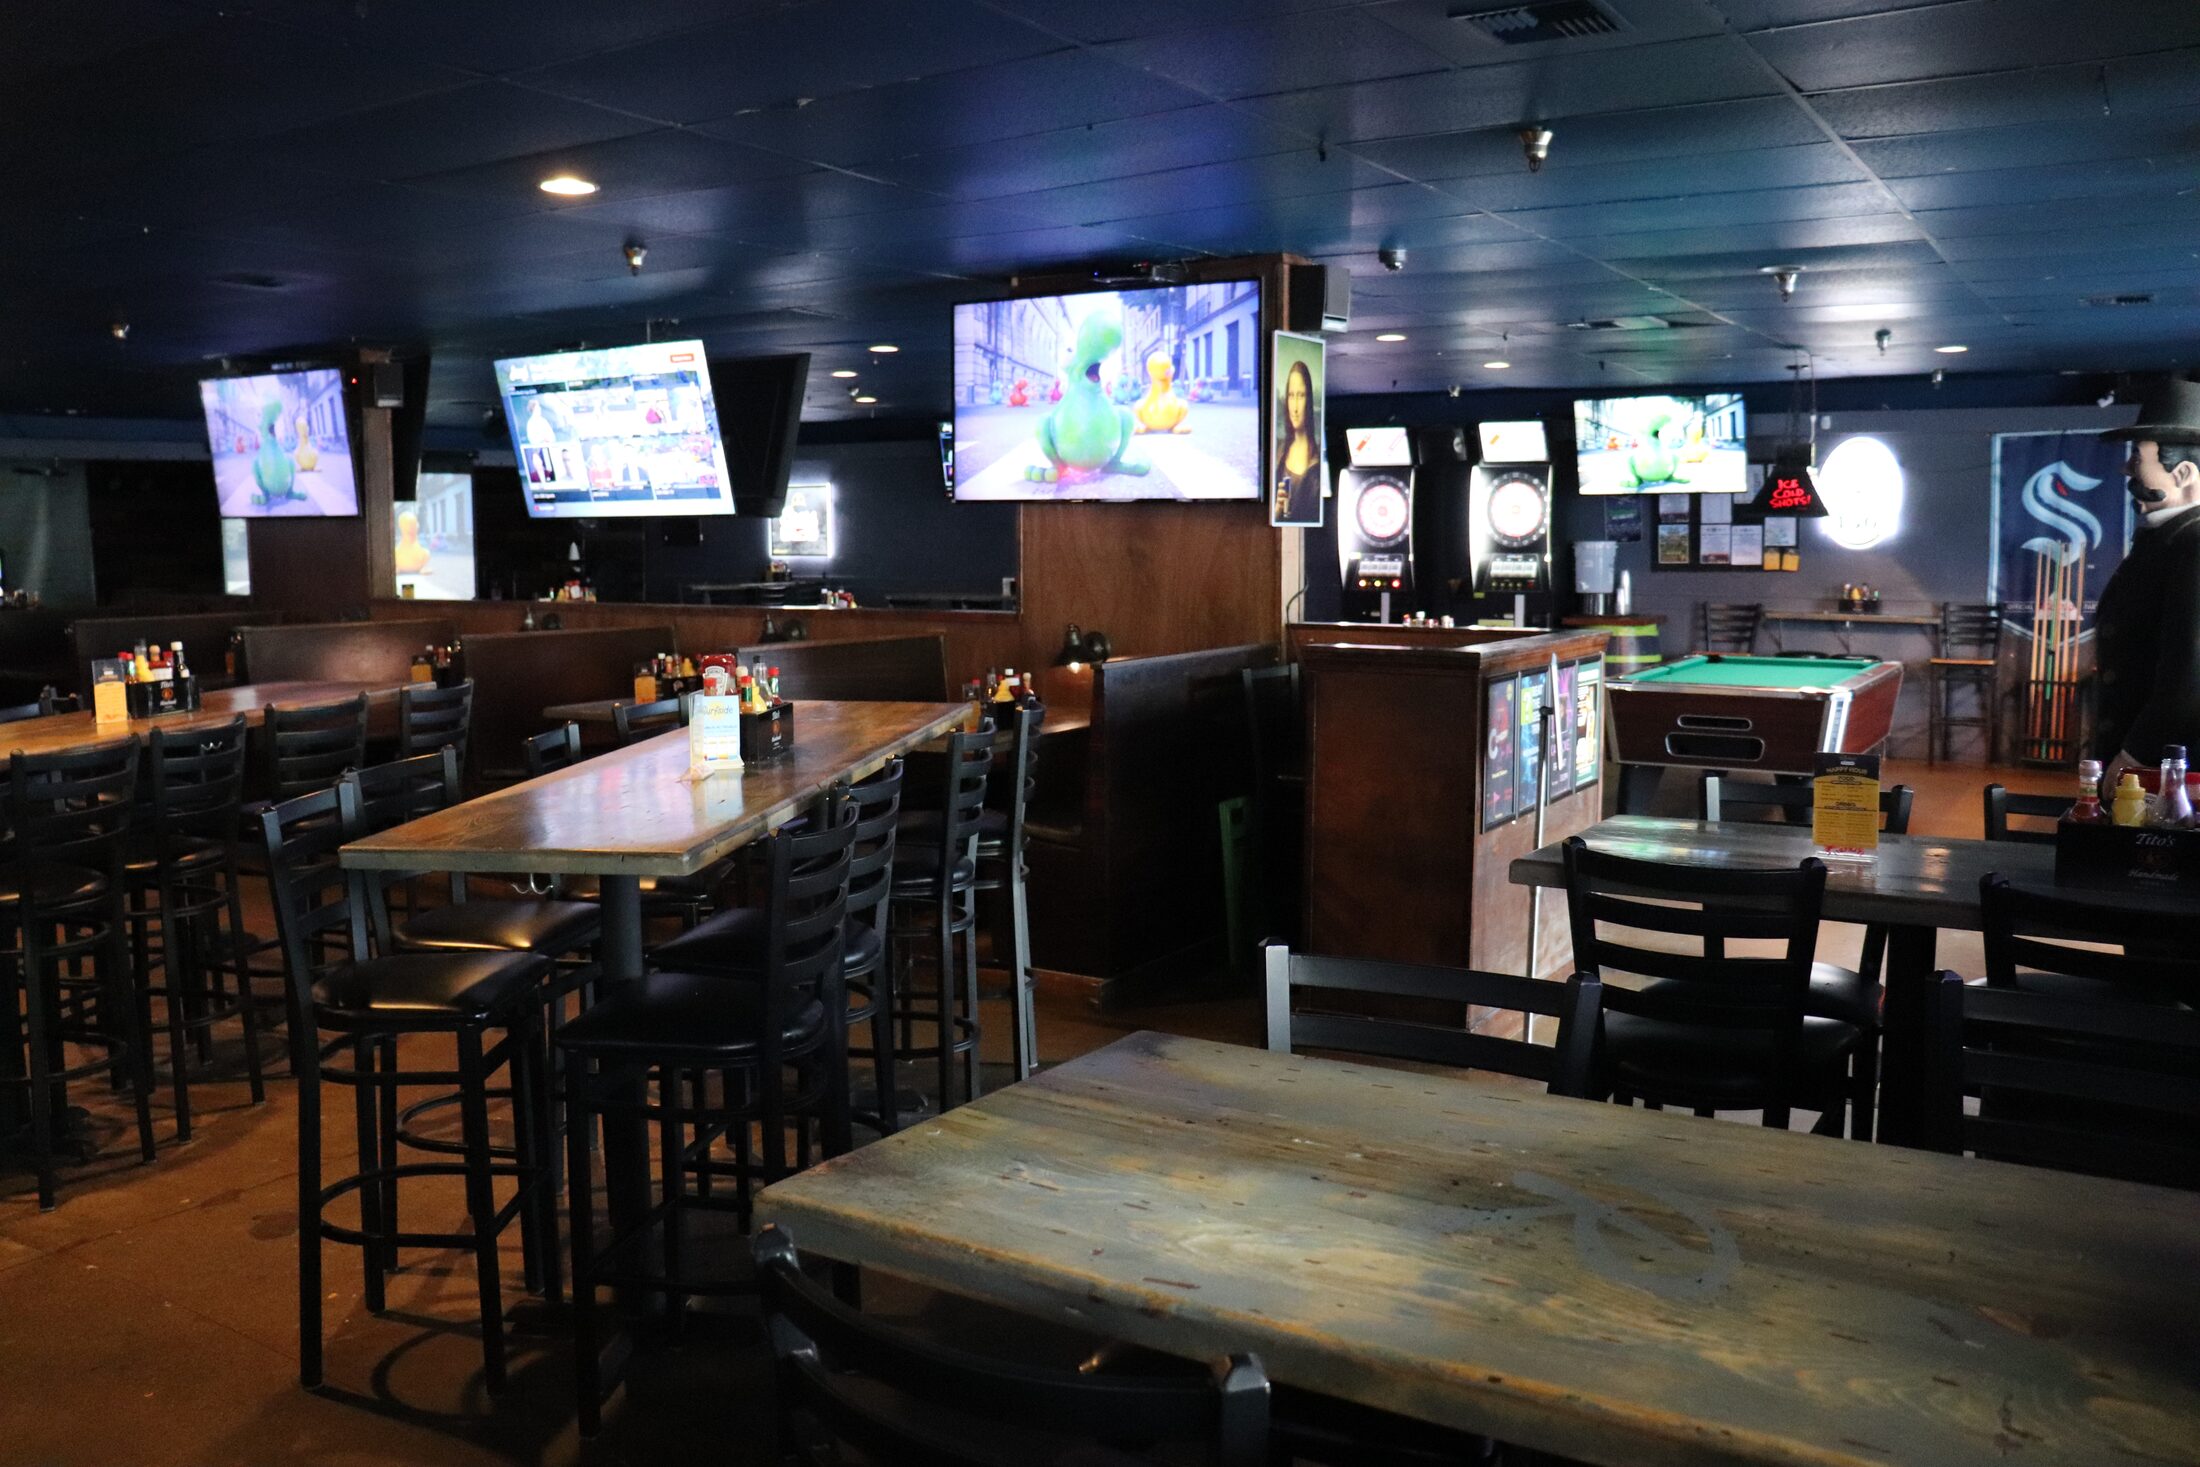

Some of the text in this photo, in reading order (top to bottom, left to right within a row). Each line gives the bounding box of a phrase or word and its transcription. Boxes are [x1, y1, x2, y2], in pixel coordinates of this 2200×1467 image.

[1777, 478, 1799, 490] ICE
[1773, 488, 1805, 499] COLD
[1769, 494, 1812, 509] SHOTS!
[1826, 766, 1868, 776] HAPPY HOUR
[2136, 833, 2176, 847] Tito's
